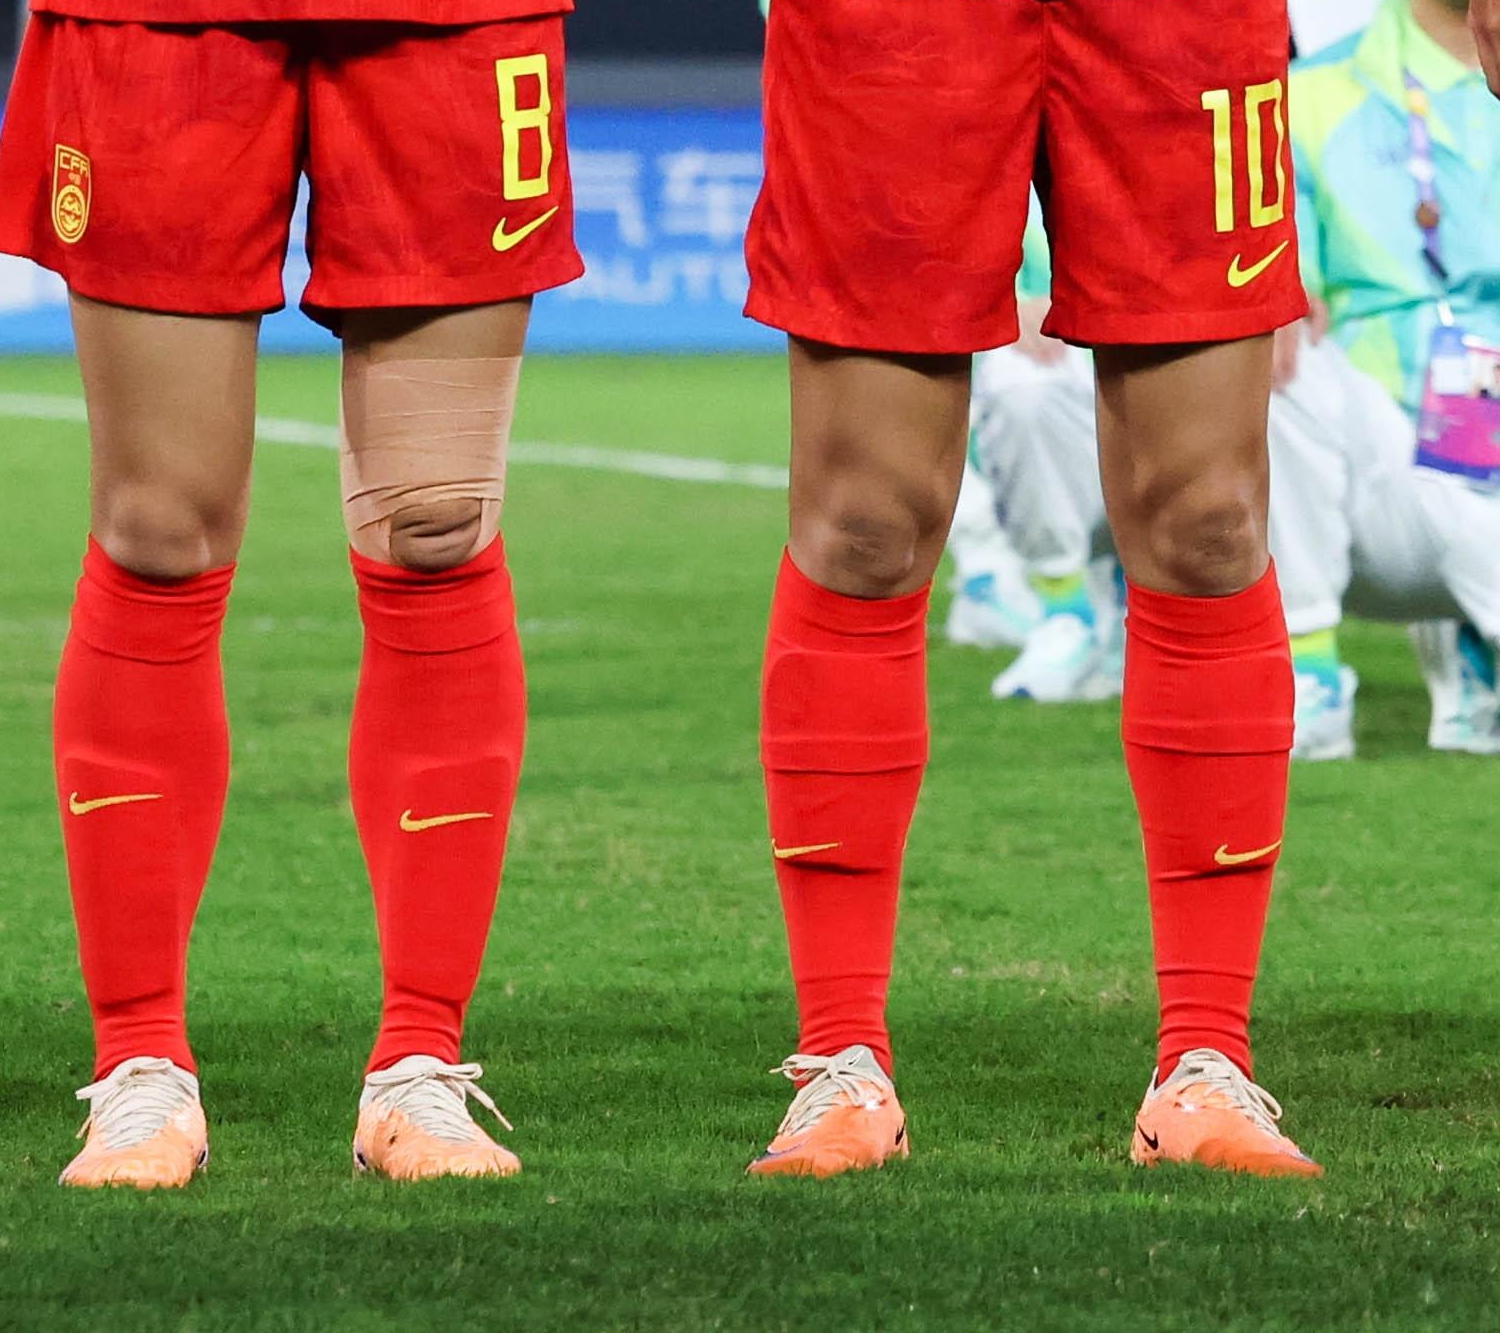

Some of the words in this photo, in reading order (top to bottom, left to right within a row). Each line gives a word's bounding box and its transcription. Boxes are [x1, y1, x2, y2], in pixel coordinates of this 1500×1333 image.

[59, 151, 89, 177] CFA
[495, 53, 553, 201] 8
[1200, 78, 1285, 233] 10
